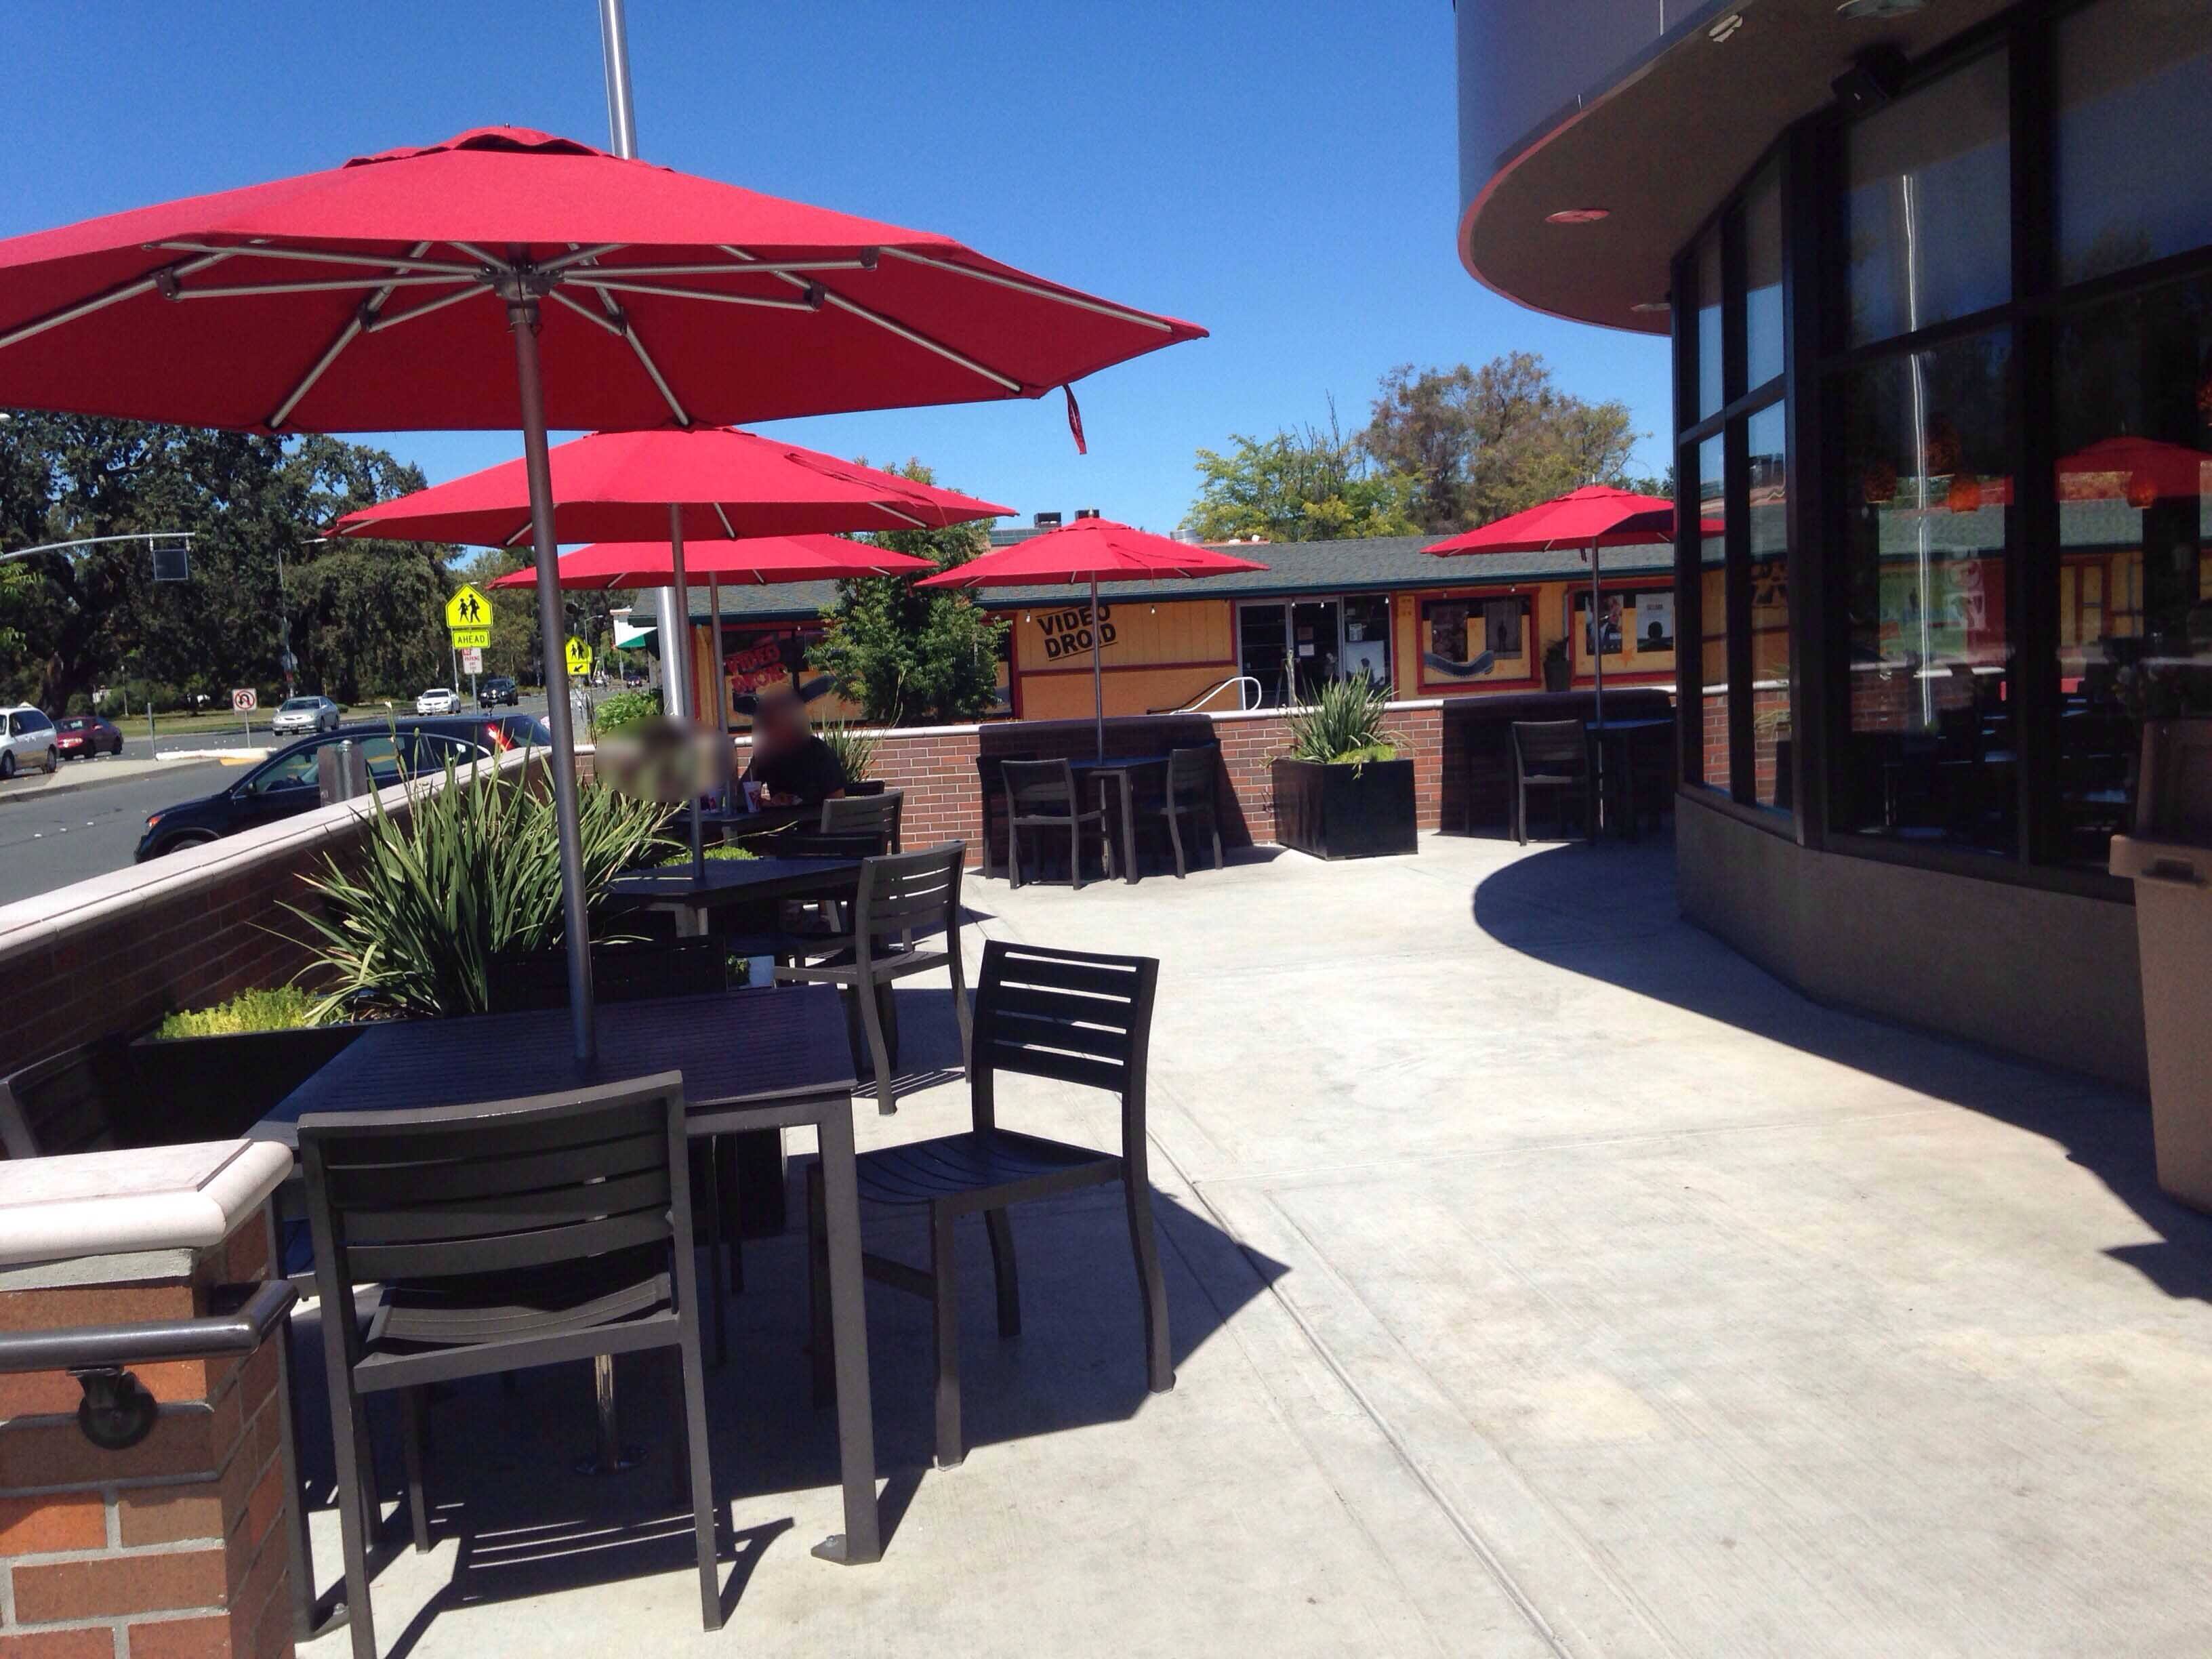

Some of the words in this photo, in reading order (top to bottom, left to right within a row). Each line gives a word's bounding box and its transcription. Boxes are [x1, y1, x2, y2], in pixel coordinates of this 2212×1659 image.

[1037, 605, 1111, 636] VIDEO
[457, 634, 485, 644] AHEAD
[1044, 623, 1117, 659] DROD
